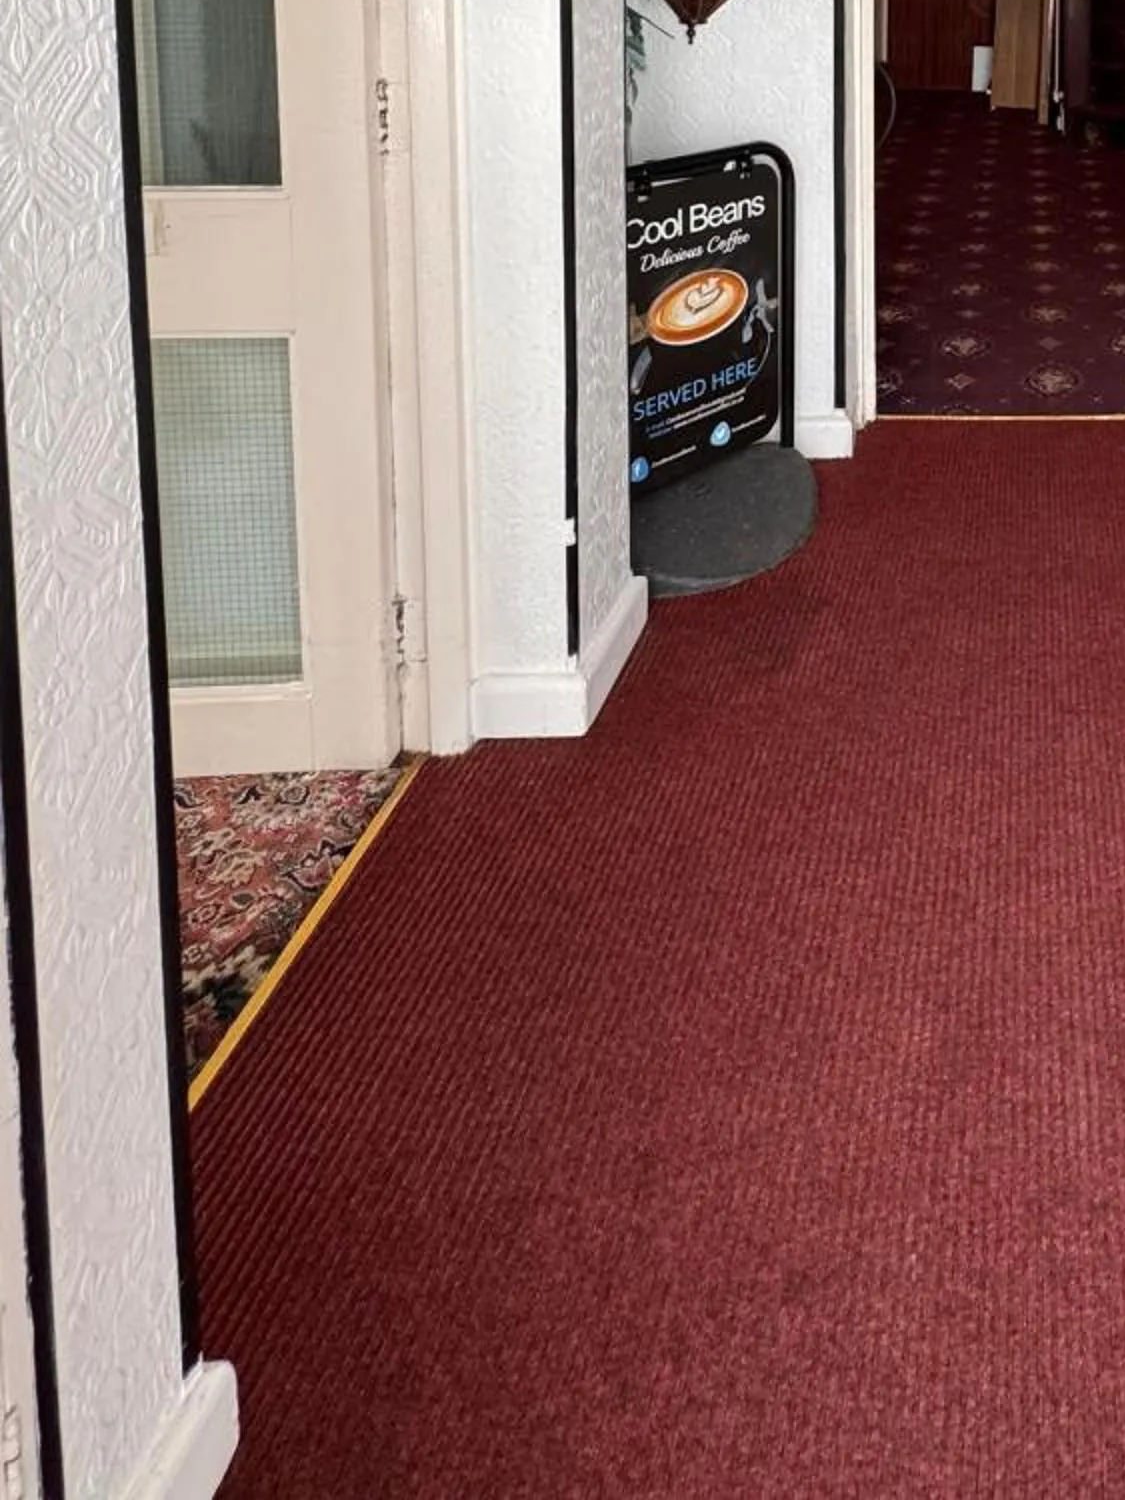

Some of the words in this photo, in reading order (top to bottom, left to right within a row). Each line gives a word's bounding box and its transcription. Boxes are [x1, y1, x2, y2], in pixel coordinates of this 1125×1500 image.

[689, 195, 765, 233] Beans
[640, 247, 703, 272] Delicious
[707, 228, 750, 254] Coffee
[633, 379, 706, 421] SERVED
[711, 357, 758, 391] HERE
